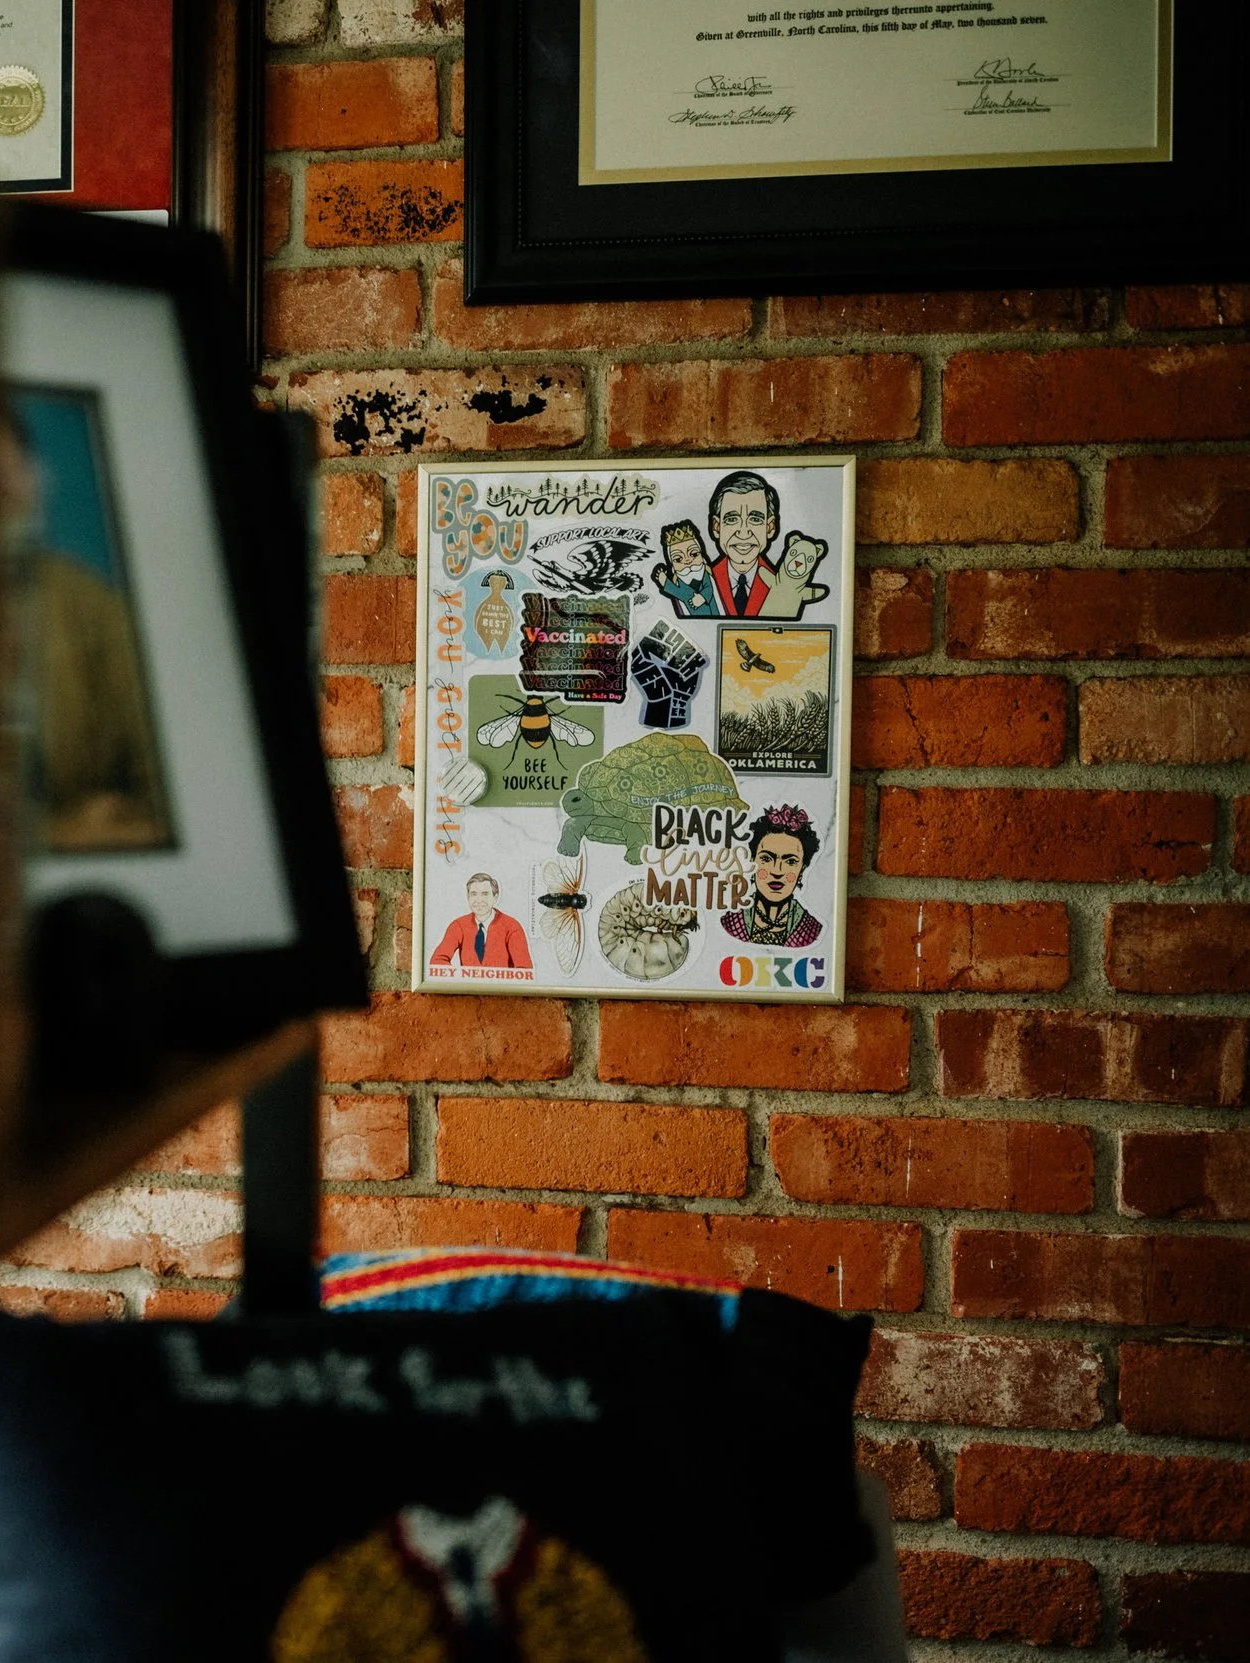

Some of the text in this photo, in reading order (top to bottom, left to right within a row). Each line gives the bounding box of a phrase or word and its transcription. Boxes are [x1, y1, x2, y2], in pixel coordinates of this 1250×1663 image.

[747, 2, 995, 23] with all the rights and privileges thereunto appertaining.
[696, 15, 1048, 42] Given at Greenville, North Carolina, this fifth day of May, two thousand seven.
[487, 476, 656, 517] wander
[536, 527, 650, 548] SUPPORT LOCAL ART
[437, 590, 463, 662] YOU
[482, 618, 507, 629] BEST
[525, 627, 626, 645] Vaccinated
[609, 693, 622, 701] Day
[437, 685, 463, 753] GOT
[524, 758, 547, 773] BEE
[729, 758, 817, 769] OKLAMERICA
[502, 776, 568, 790] YOURSELF
[631, 784, 734, 806] ENJOY THE JOURNEY
[654, 805, 751, 850] BLACK
[646, 868, 750, 910] MATTER
[429, 967, 534, 981] HEY NEIGHBOR
[719, 955, 825, 989] OKC
